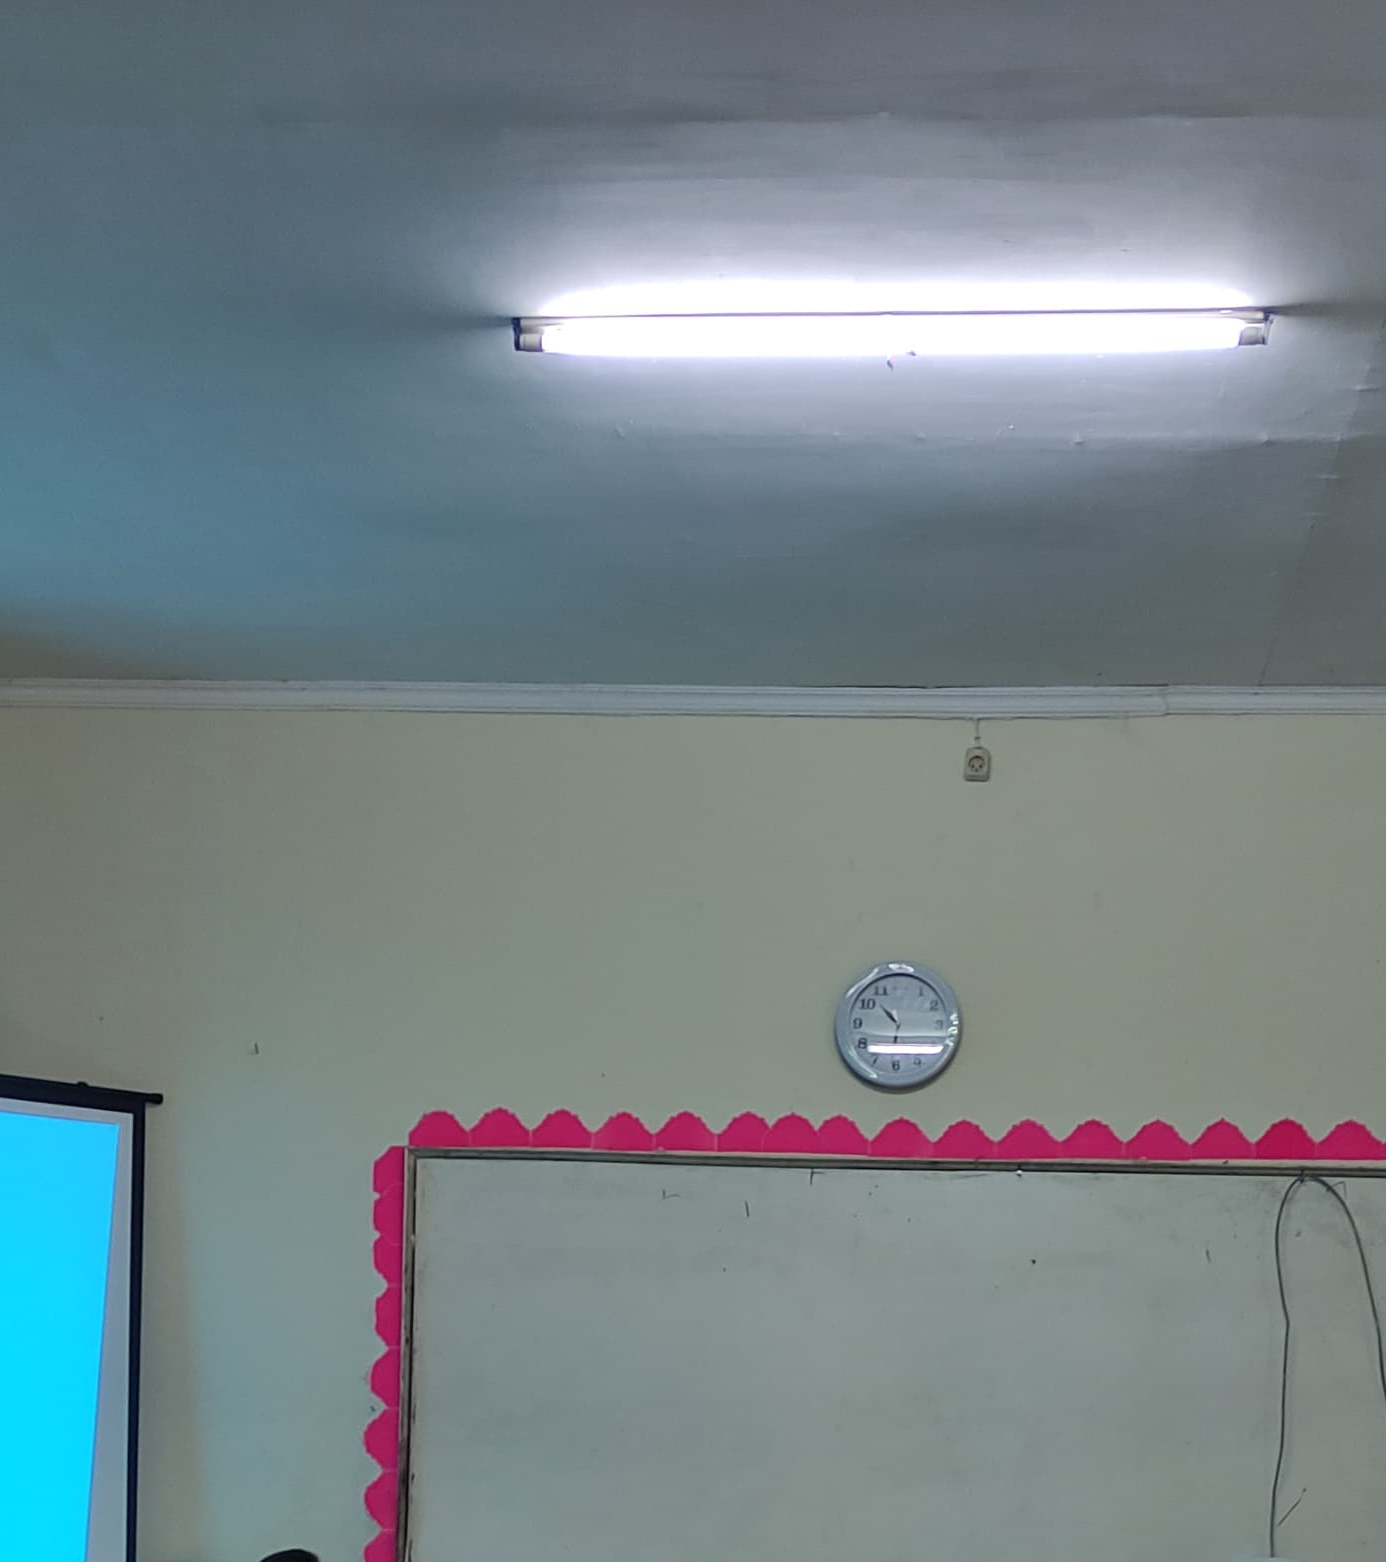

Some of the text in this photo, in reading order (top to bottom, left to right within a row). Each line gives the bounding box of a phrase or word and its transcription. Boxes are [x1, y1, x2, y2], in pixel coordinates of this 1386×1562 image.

[874, 986, 888, 996] 11
[860, 999, 876, 1010] 10
[929, 1000, 938, 1011] 2
[853, 1018, 863, 1029] 9
[857, 1038, 868, 1050] 8
[892, 1060, 901, 1071] 6
